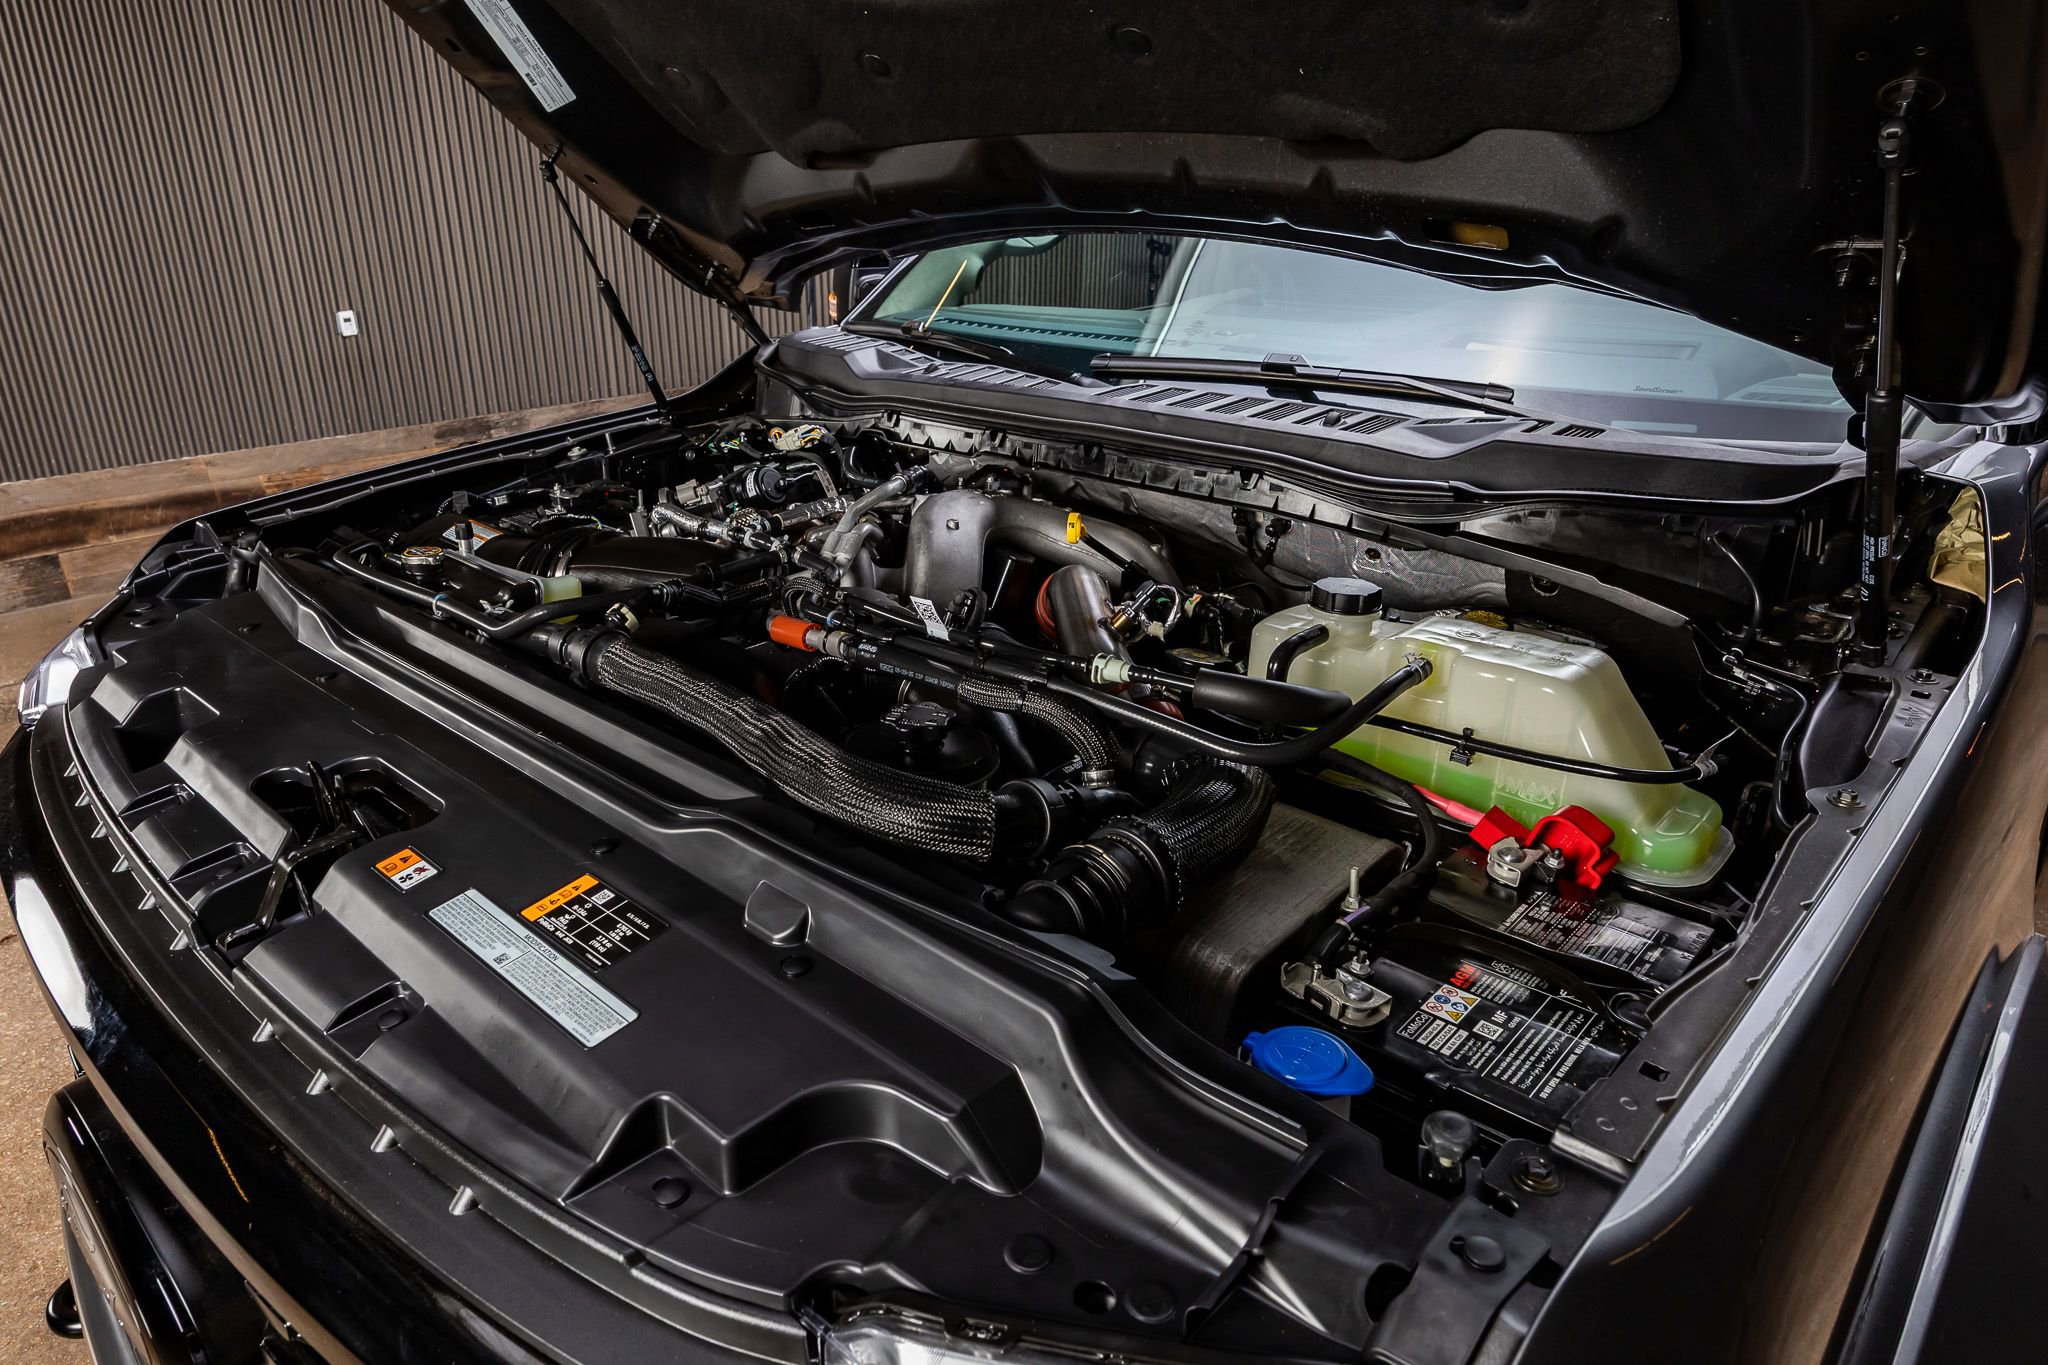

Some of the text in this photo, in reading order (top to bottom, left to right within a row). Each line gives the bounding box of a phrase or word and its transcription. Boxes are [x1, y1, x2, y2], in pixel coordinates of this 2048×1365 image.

[524, 36, 538, 53] EMISSION
[535, 51, 548, 67] CONTROL
[546, 66, 563, 88] INFORMATION
[535, 917, 557, 932] FoMoCo
[522, 933, 560, 962] MODIFICATION
[1449, 961, 1475, 987] AGM
[1400, 1011, 1429, 1037] FoMoCo
[1491, 1007, 1508, 1024] MF
